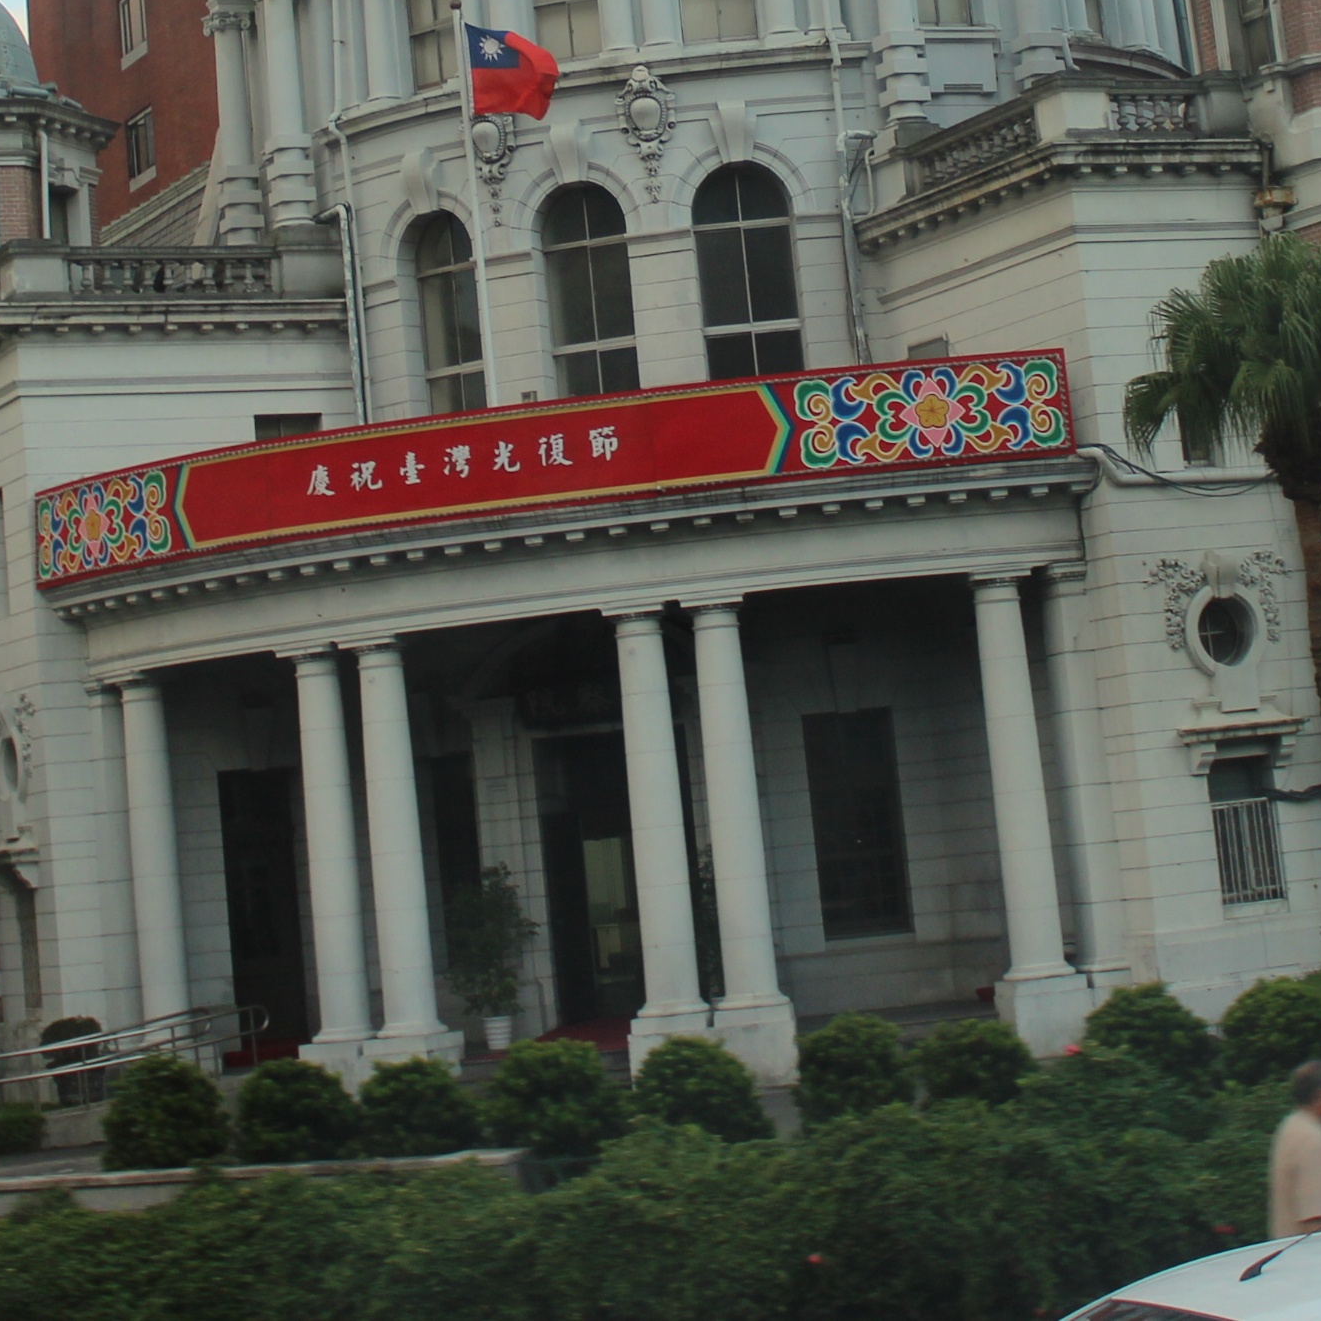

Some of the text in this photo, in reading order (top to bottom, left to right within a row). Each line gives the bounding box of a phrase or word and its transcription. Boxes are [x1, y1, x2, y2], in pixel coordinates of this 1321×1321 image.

[306, 426, 619, 496] 慶祝臺灣光復節
